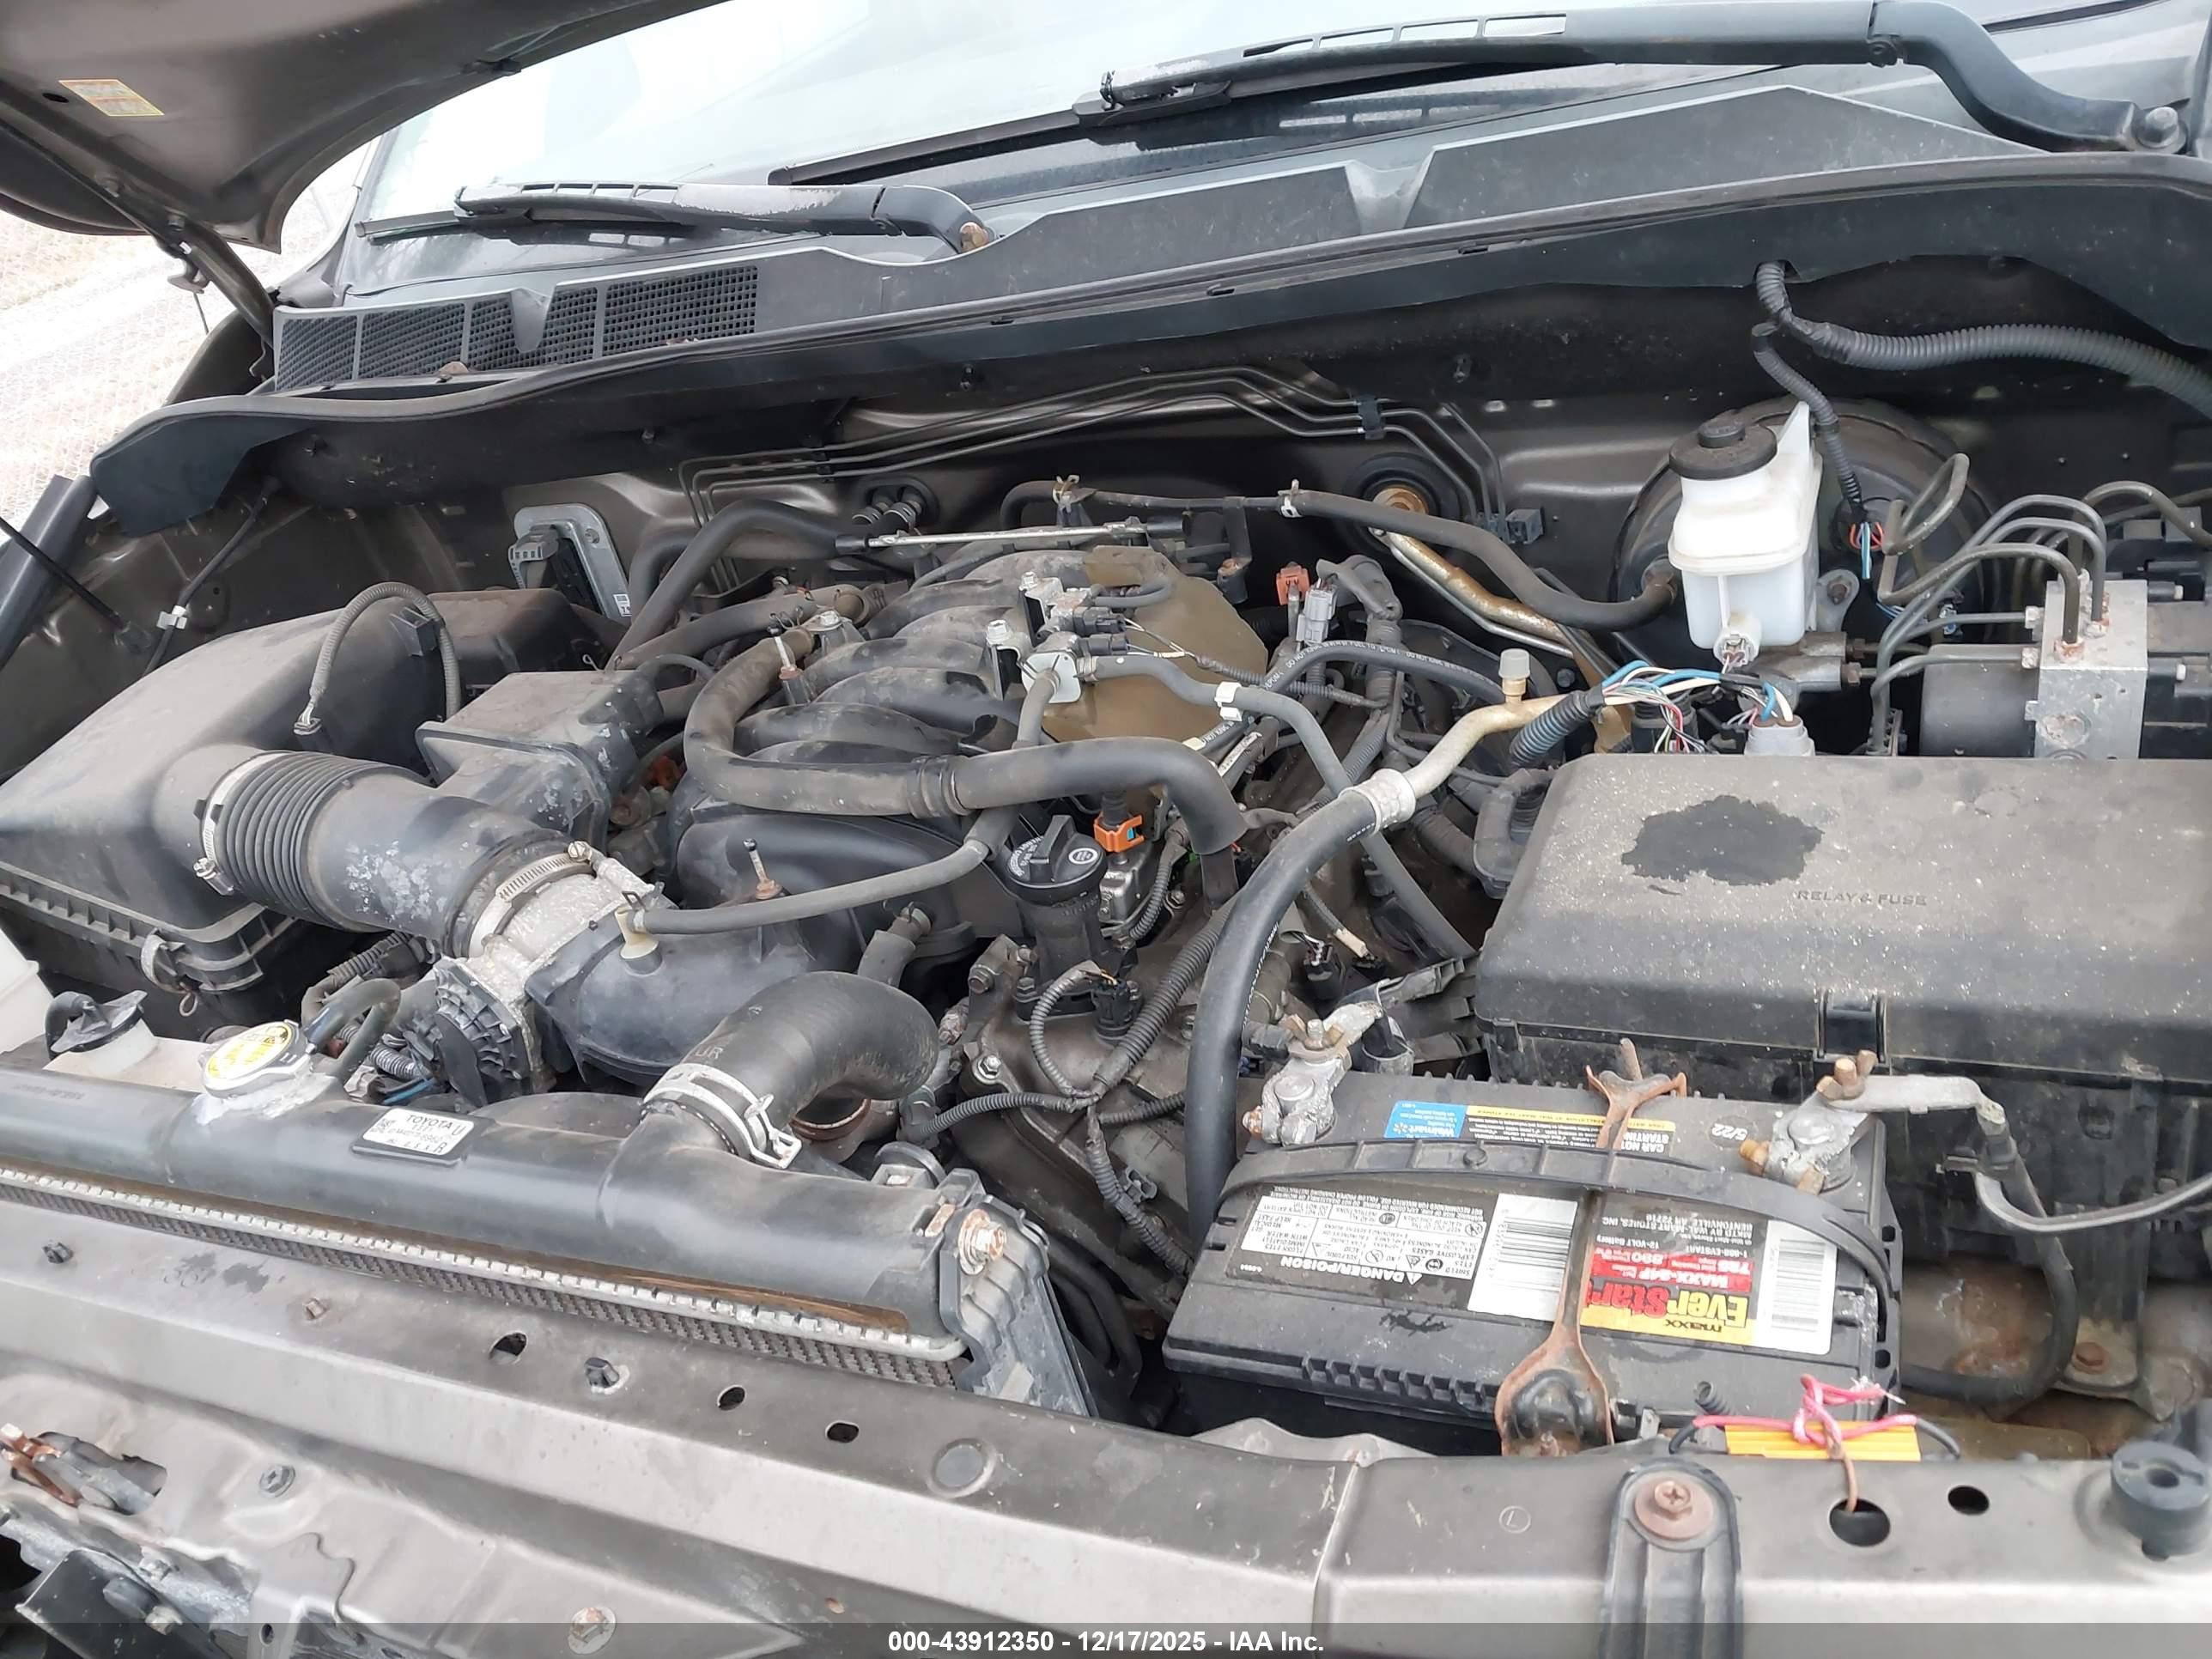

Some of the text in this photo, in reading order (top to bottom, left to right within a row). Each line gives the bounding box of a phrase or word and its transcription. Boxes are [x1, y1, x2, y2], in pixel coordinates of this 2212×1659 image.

[1796, 890, 1927, 906] RELAY & FUSE
[406, 1115, 453, 1129] TOYOTA
[1407, 1125, 1455, 1137] Walmart
[1711, 1123, 1748, 1141] 5/22
[1623, 1132, 1669, 1144] STARTIN
[1641, 1142, 1664, 1153] CAR
[1657, 1223, 1708, 1235] WAL-MART
[1711, 1228, 1723, 1237] BY
[1262, 1237, 1305, 1247] IMMEDIATELY
[1596, 1234, 1626, 1245] Battery
[1437, 1251, 1474, 1260] EXPLOSIVE
[1279, 1255, 1405, 1284] DANGER/POISON
[1445, 1267, 1471, 1276] SHIELD
[1662, 1319, 1723, 1334] maxx
